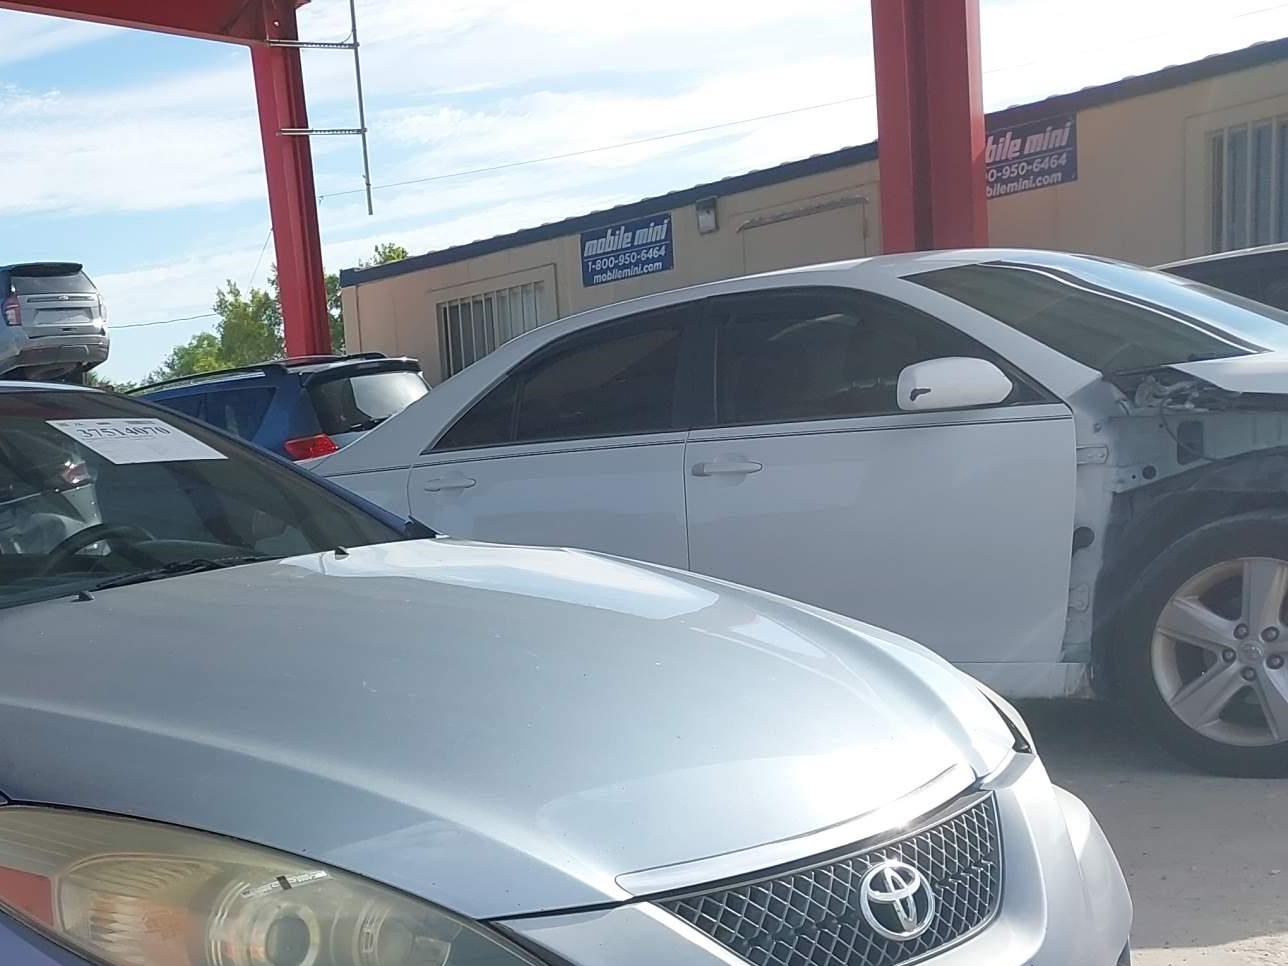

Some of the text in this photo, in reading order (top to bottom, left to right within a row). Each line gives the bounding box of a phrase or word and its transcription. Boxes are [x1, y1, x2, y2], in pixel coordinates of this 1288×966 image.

[985, 121, 1071, 163] bile mini
[985, 152, 1067, 182] 0-950-6464
[985, 172, 1062, 198] bilemini.com
[584, 219, 669, 257] mobile mini
[588, 245, 666, 272] 1-800-950-6464
[593, 262, 663, 284] mobilemini.com
[77, 426, 171, 438] 37514070
